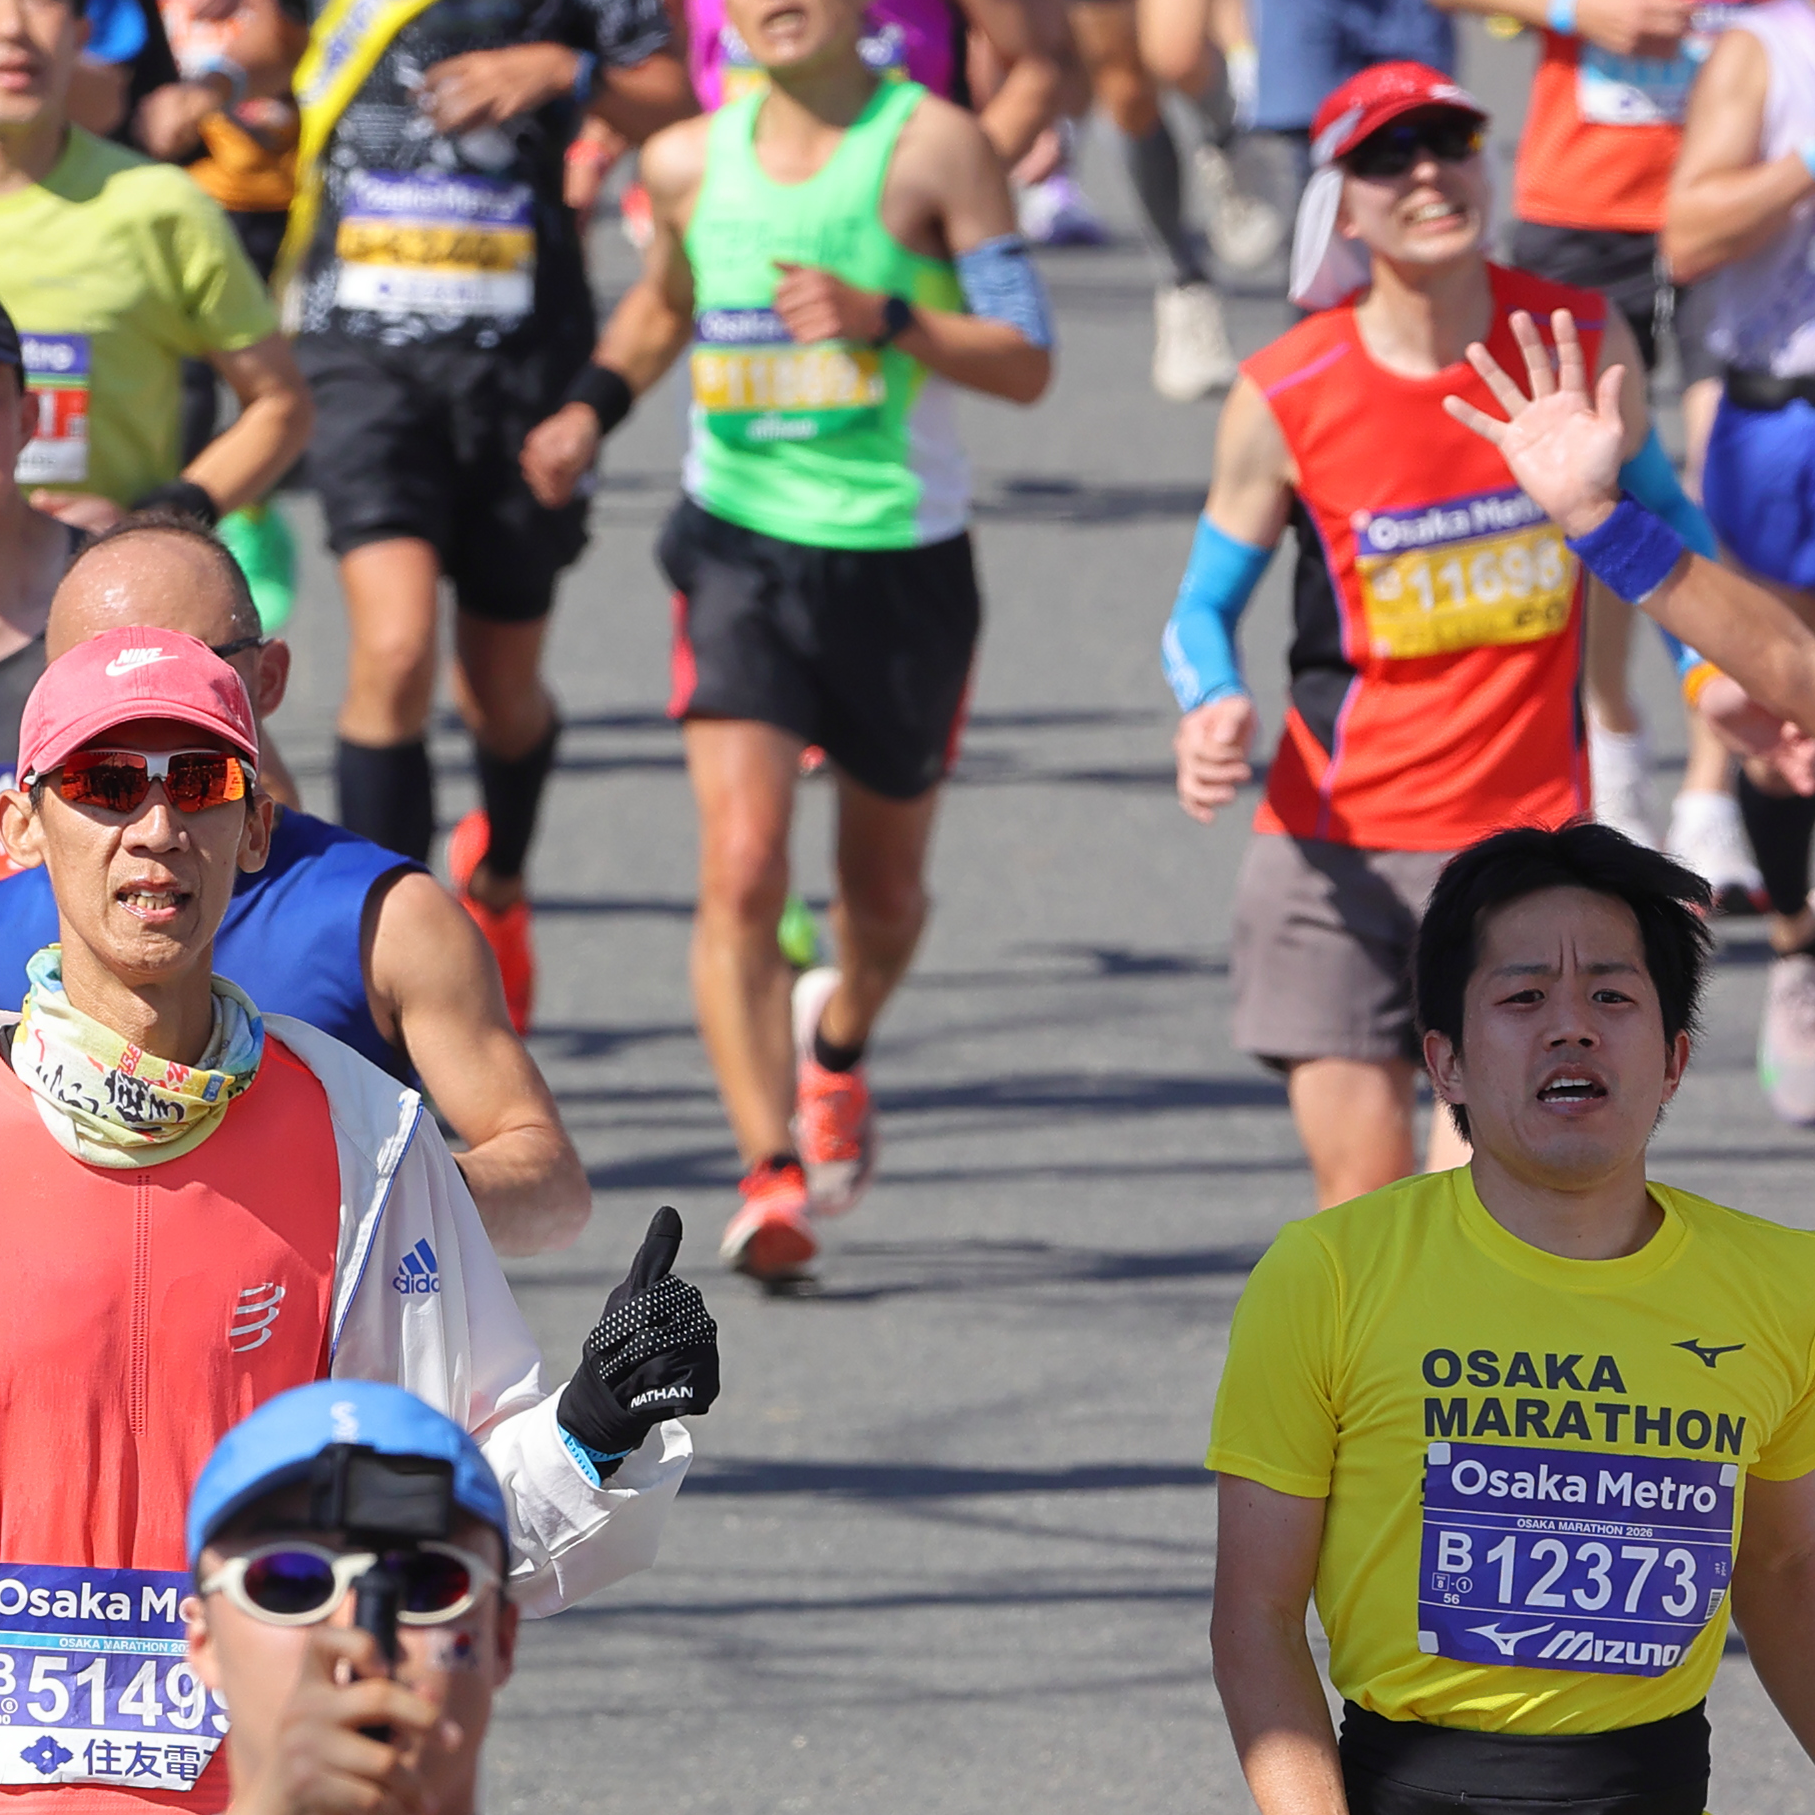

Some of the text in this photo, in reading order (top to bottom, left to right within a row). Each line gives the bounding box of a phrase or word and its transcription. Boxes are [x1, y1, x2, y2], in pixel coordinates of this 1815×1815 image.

[21, 340, 76, 370] tro
[1367, 509, 1471, 552] Osaka
[116, 647, 163, 665] NIKE
[1421, 1348, 1628, 1395] OSAKA
[630, 1386, 694, 1409] NATHAN
[1423, 1396, 1747, 1457] MARATHON
[1450, 1459, 1718, 1514] Osaka Metro
[1516, 1517, 1654, 1539] OSAKA MARATHON 2026
[1437, 1530, 1698, 1618] B 12373
[1442, 1593, 1461, 1605] 56
[58, 1637, 191, 1653] OSAKA MARATHON 20
[83, 1738, 215, 1782] 住友電
